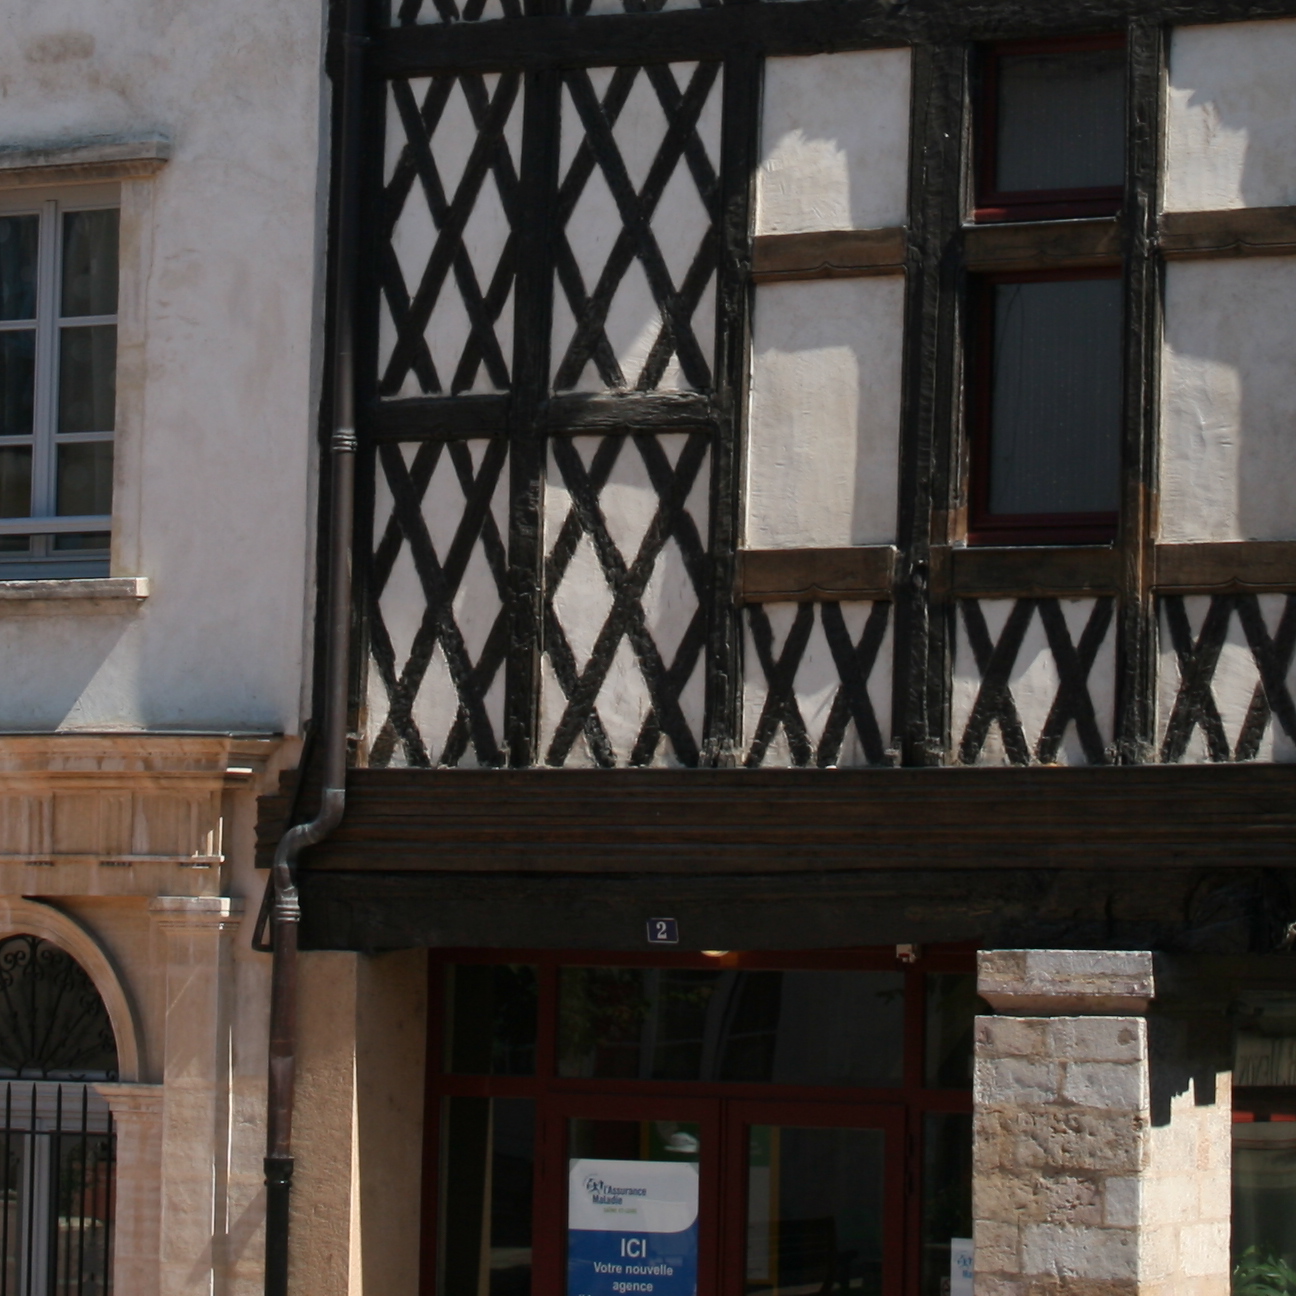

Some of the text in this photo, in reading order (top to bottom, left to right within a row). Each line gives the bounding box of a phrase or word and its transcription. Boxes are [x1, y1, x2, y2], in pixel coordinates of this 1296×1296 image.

[656, 921, 667, 939] 2
[593, 1194, 623, 1205] Maladie
[621, 1238, 647, 1258] ICI
[593, 1262, 673, 1276] Votre nouvelle
[612, 1281, 653, 1293] agence
